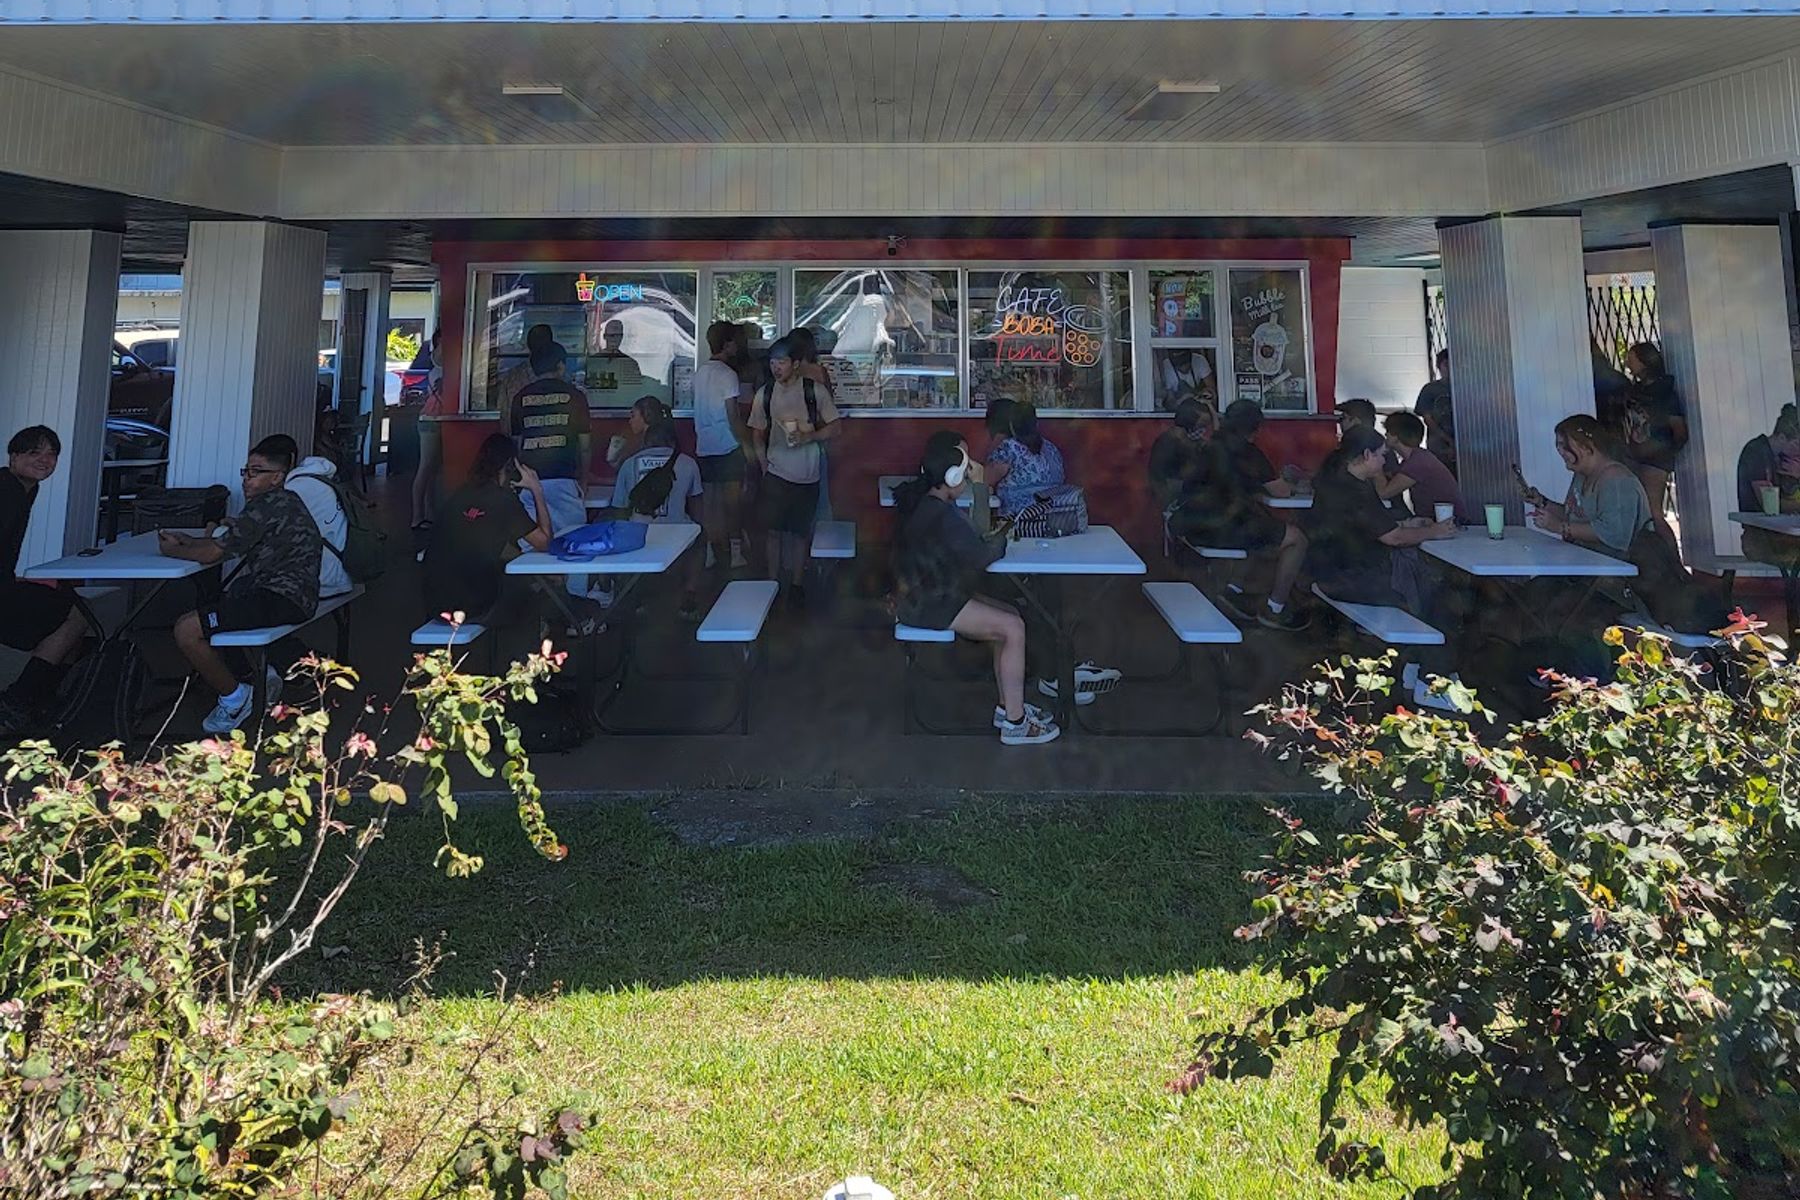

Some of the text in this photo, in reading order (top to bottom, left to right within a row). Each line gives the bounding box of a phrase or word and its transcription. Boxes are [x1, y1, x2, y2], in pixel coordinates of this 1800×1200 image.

[594, 284, 642, 301] OPEN
[996, 285, 1065, 315] CAFE
[1240, 288, 1286, 311] Bubble
[1003, 314, 1054, 336] BOBA
[991, 334, 1063, 368] Time
